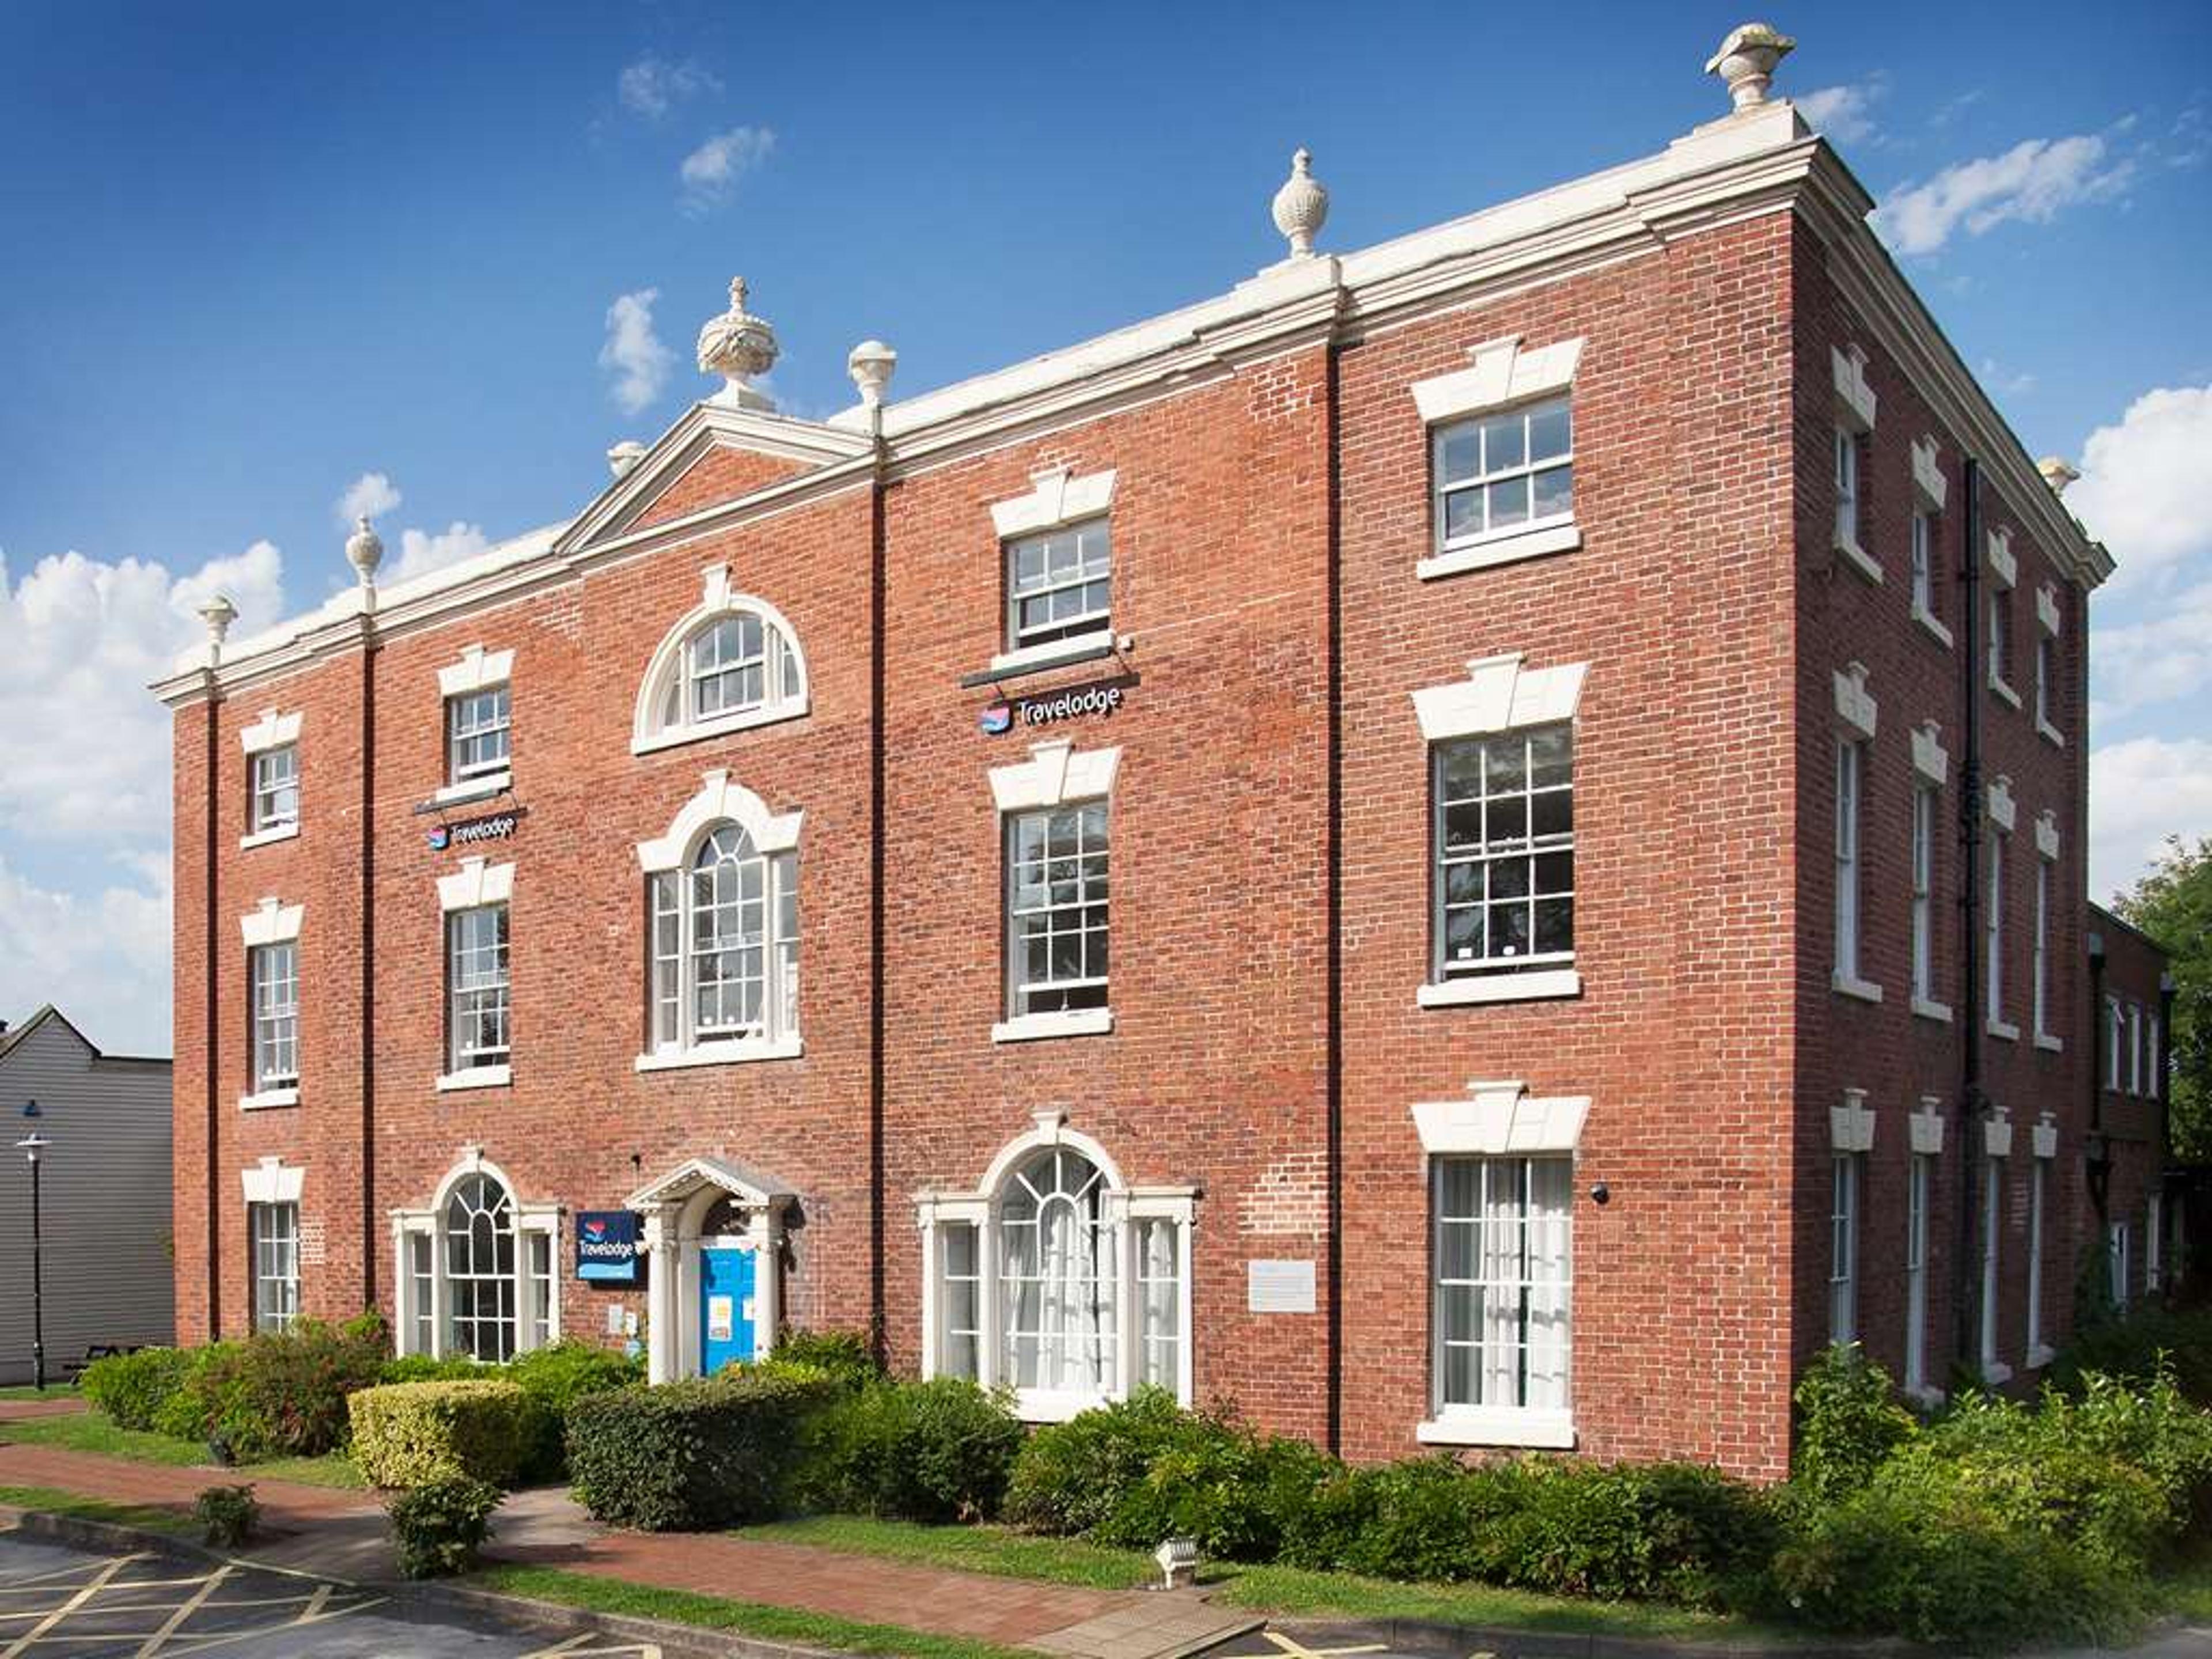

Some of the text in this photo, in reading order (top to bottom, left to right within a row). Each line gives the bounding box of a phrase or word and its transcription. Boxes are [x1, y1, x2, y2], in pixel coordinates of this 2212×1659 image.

[1019, 687, 1120, 722] Travelodge
[451, 817, 515, 840] Travelodge
[579, 1239, 634, 1258] Travelodge
